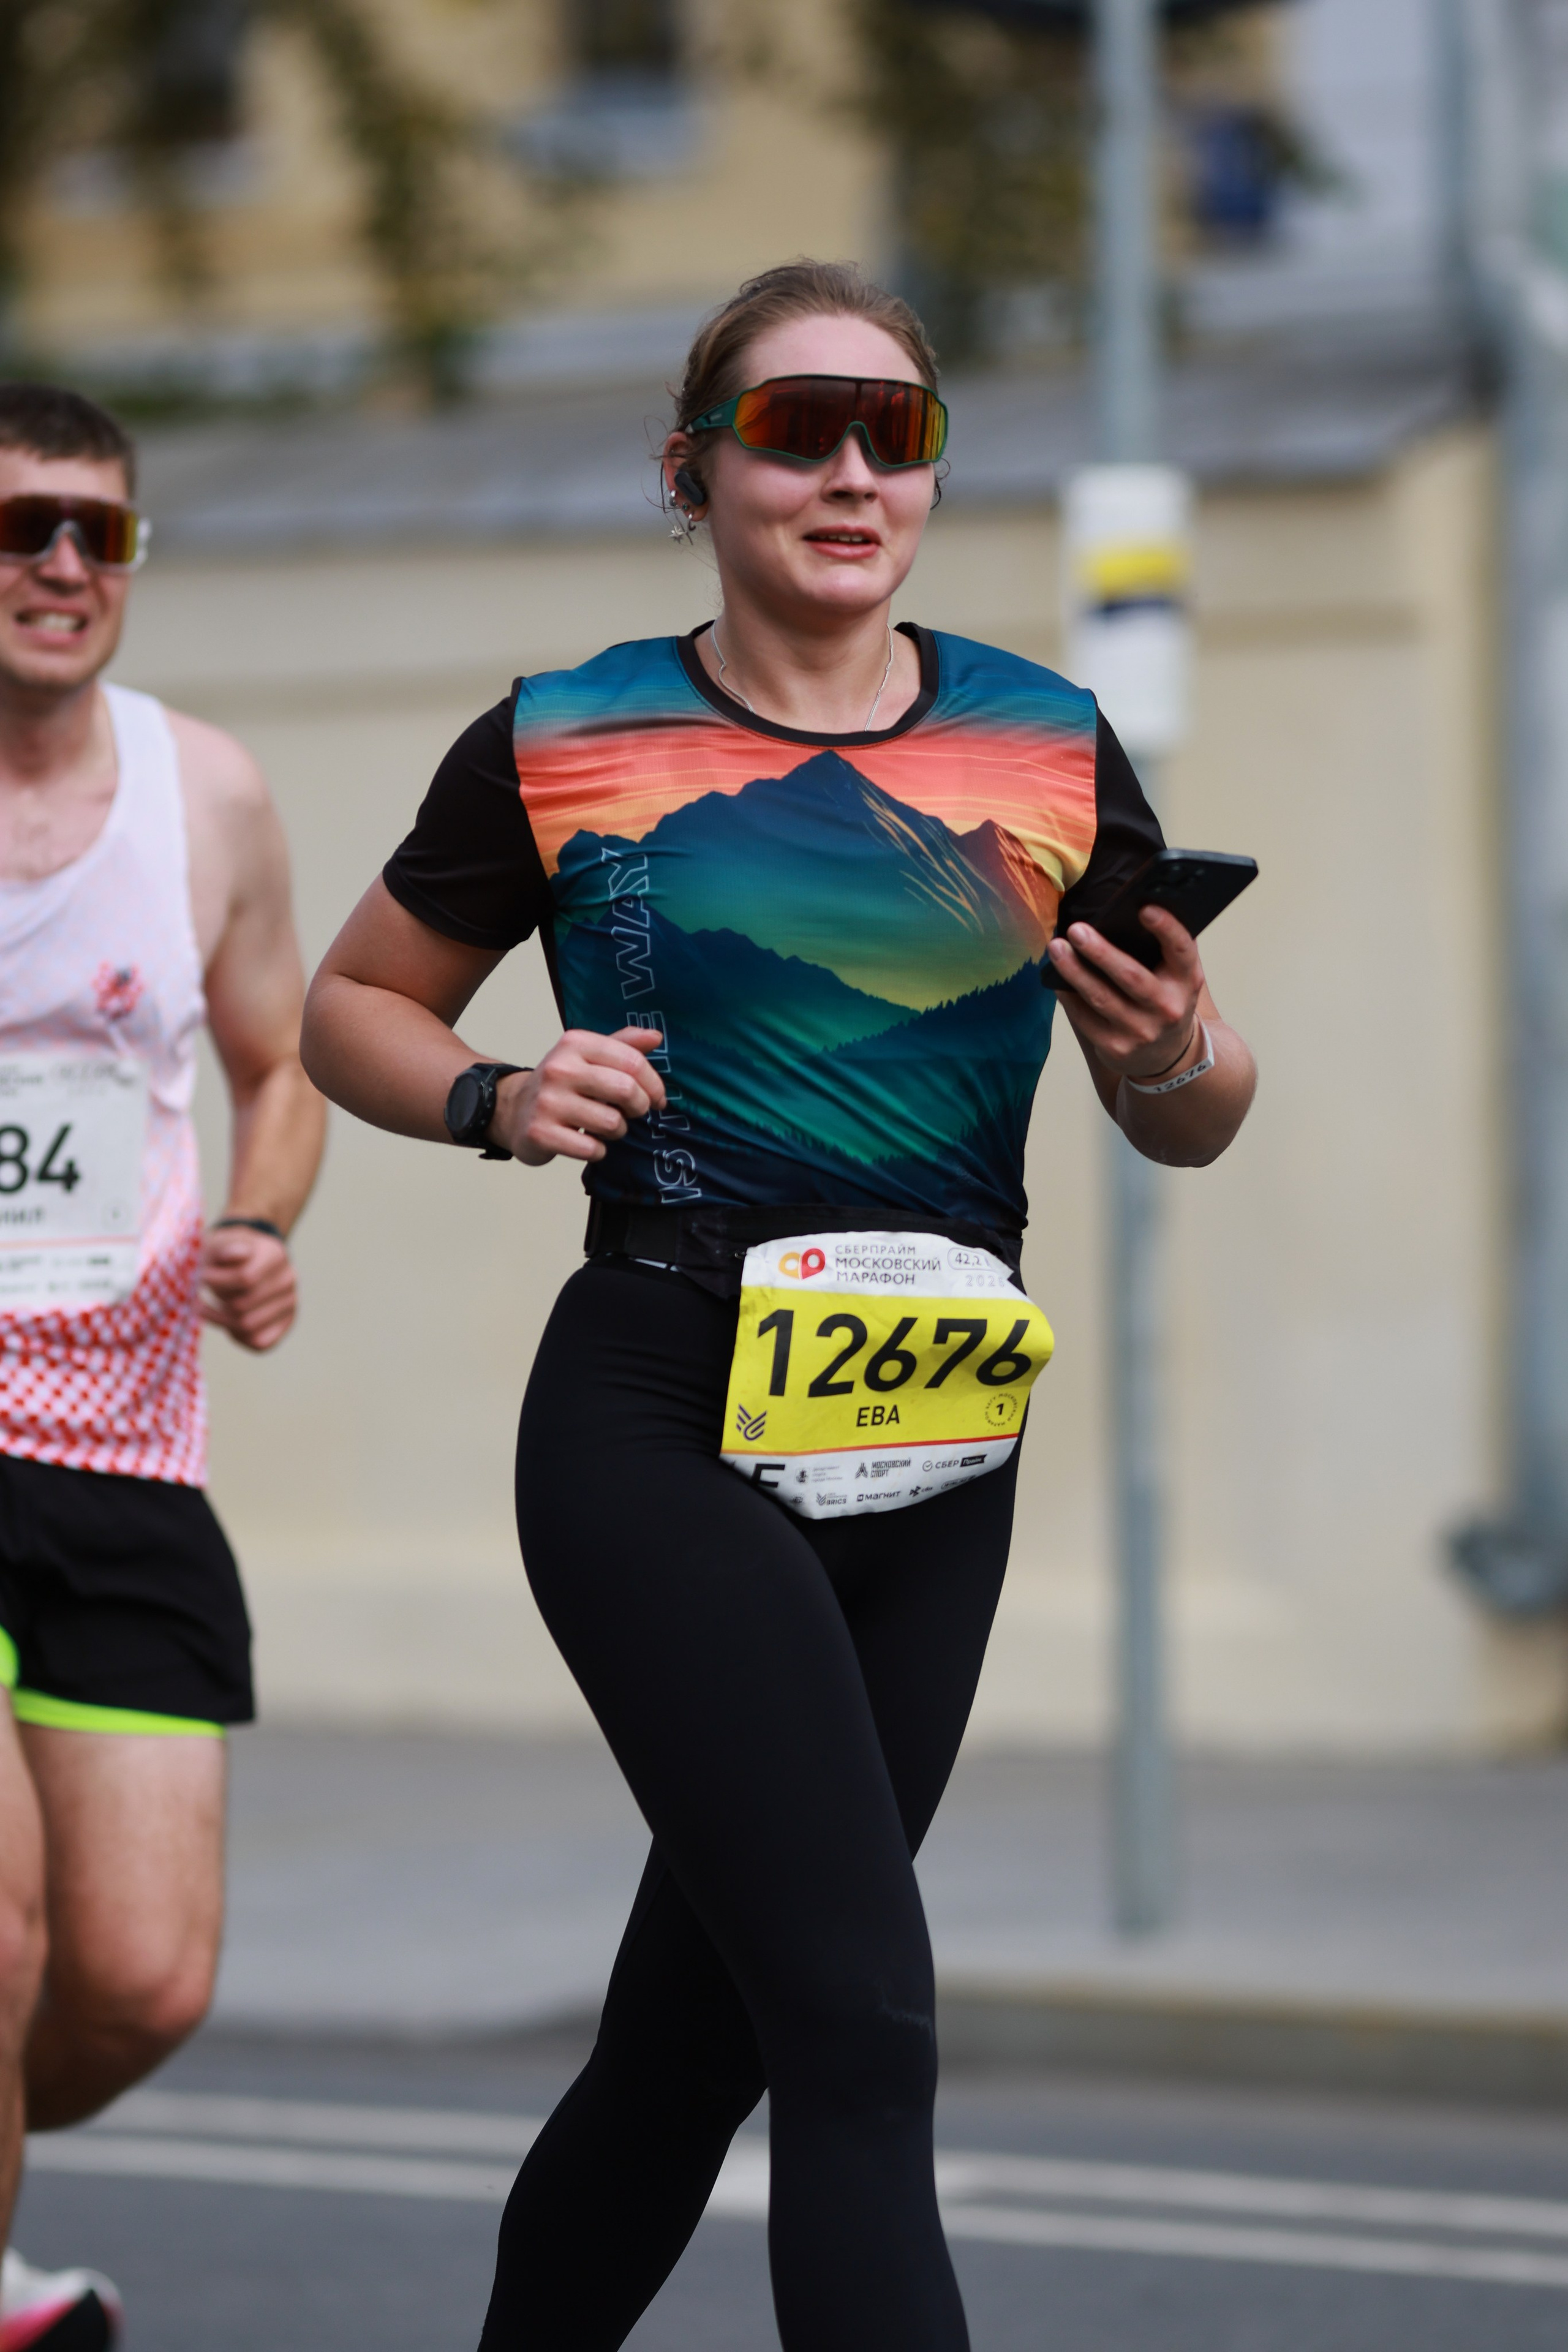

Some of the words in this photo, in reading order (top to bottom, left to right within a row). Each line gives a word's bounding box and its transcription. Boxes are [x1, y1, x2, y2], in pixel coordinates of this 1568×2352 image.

[601, 848, 655, 1000] WAY
[1153, 1065, 1206, 1091] 12676
[654, 1148, 702, 1204] IS
[835, 1245, 916, 1255] СБЕРПРАЙМ
[835, 1257, 941, 1272] МОСКОВСКИЙ
[836, 1271, 915, 1285] МАРАФОН
[757, 1309, 1033, 1398] 12676
[856, 1405, 900, 1428] ЕВА
[996, 1403, 1005, 1416] 1
[872, 1458, 911, 1469] МОСКОВСКИЙ
[935, 1460, 960, 1469] СБЕР
[870, 1469, 889, 1478] СПОРТ
